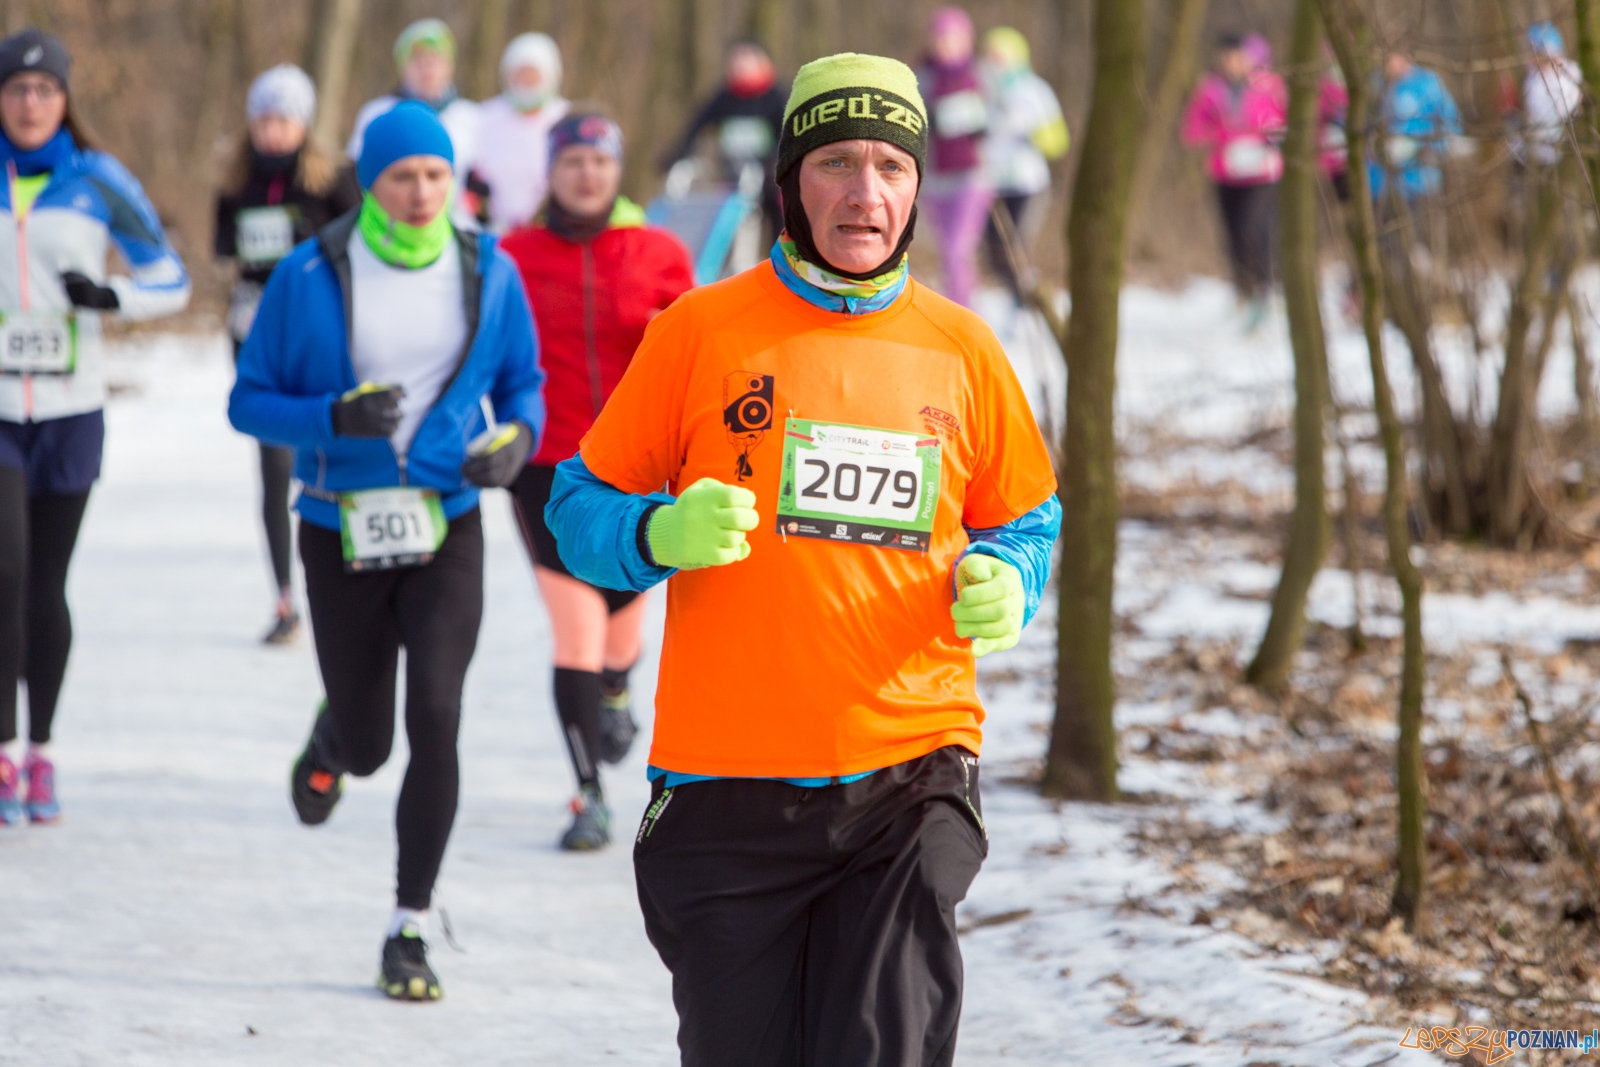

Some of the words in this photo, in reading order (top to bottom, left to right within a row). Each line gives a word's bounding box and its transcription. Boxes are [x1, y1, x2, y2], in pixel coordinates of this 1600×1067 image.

[8, 330, 61, 358] 853
[801, 459, 917, 509] 2079
[921, 481, 935, 519] Poznań
[368, 511, 422, 543] 501
